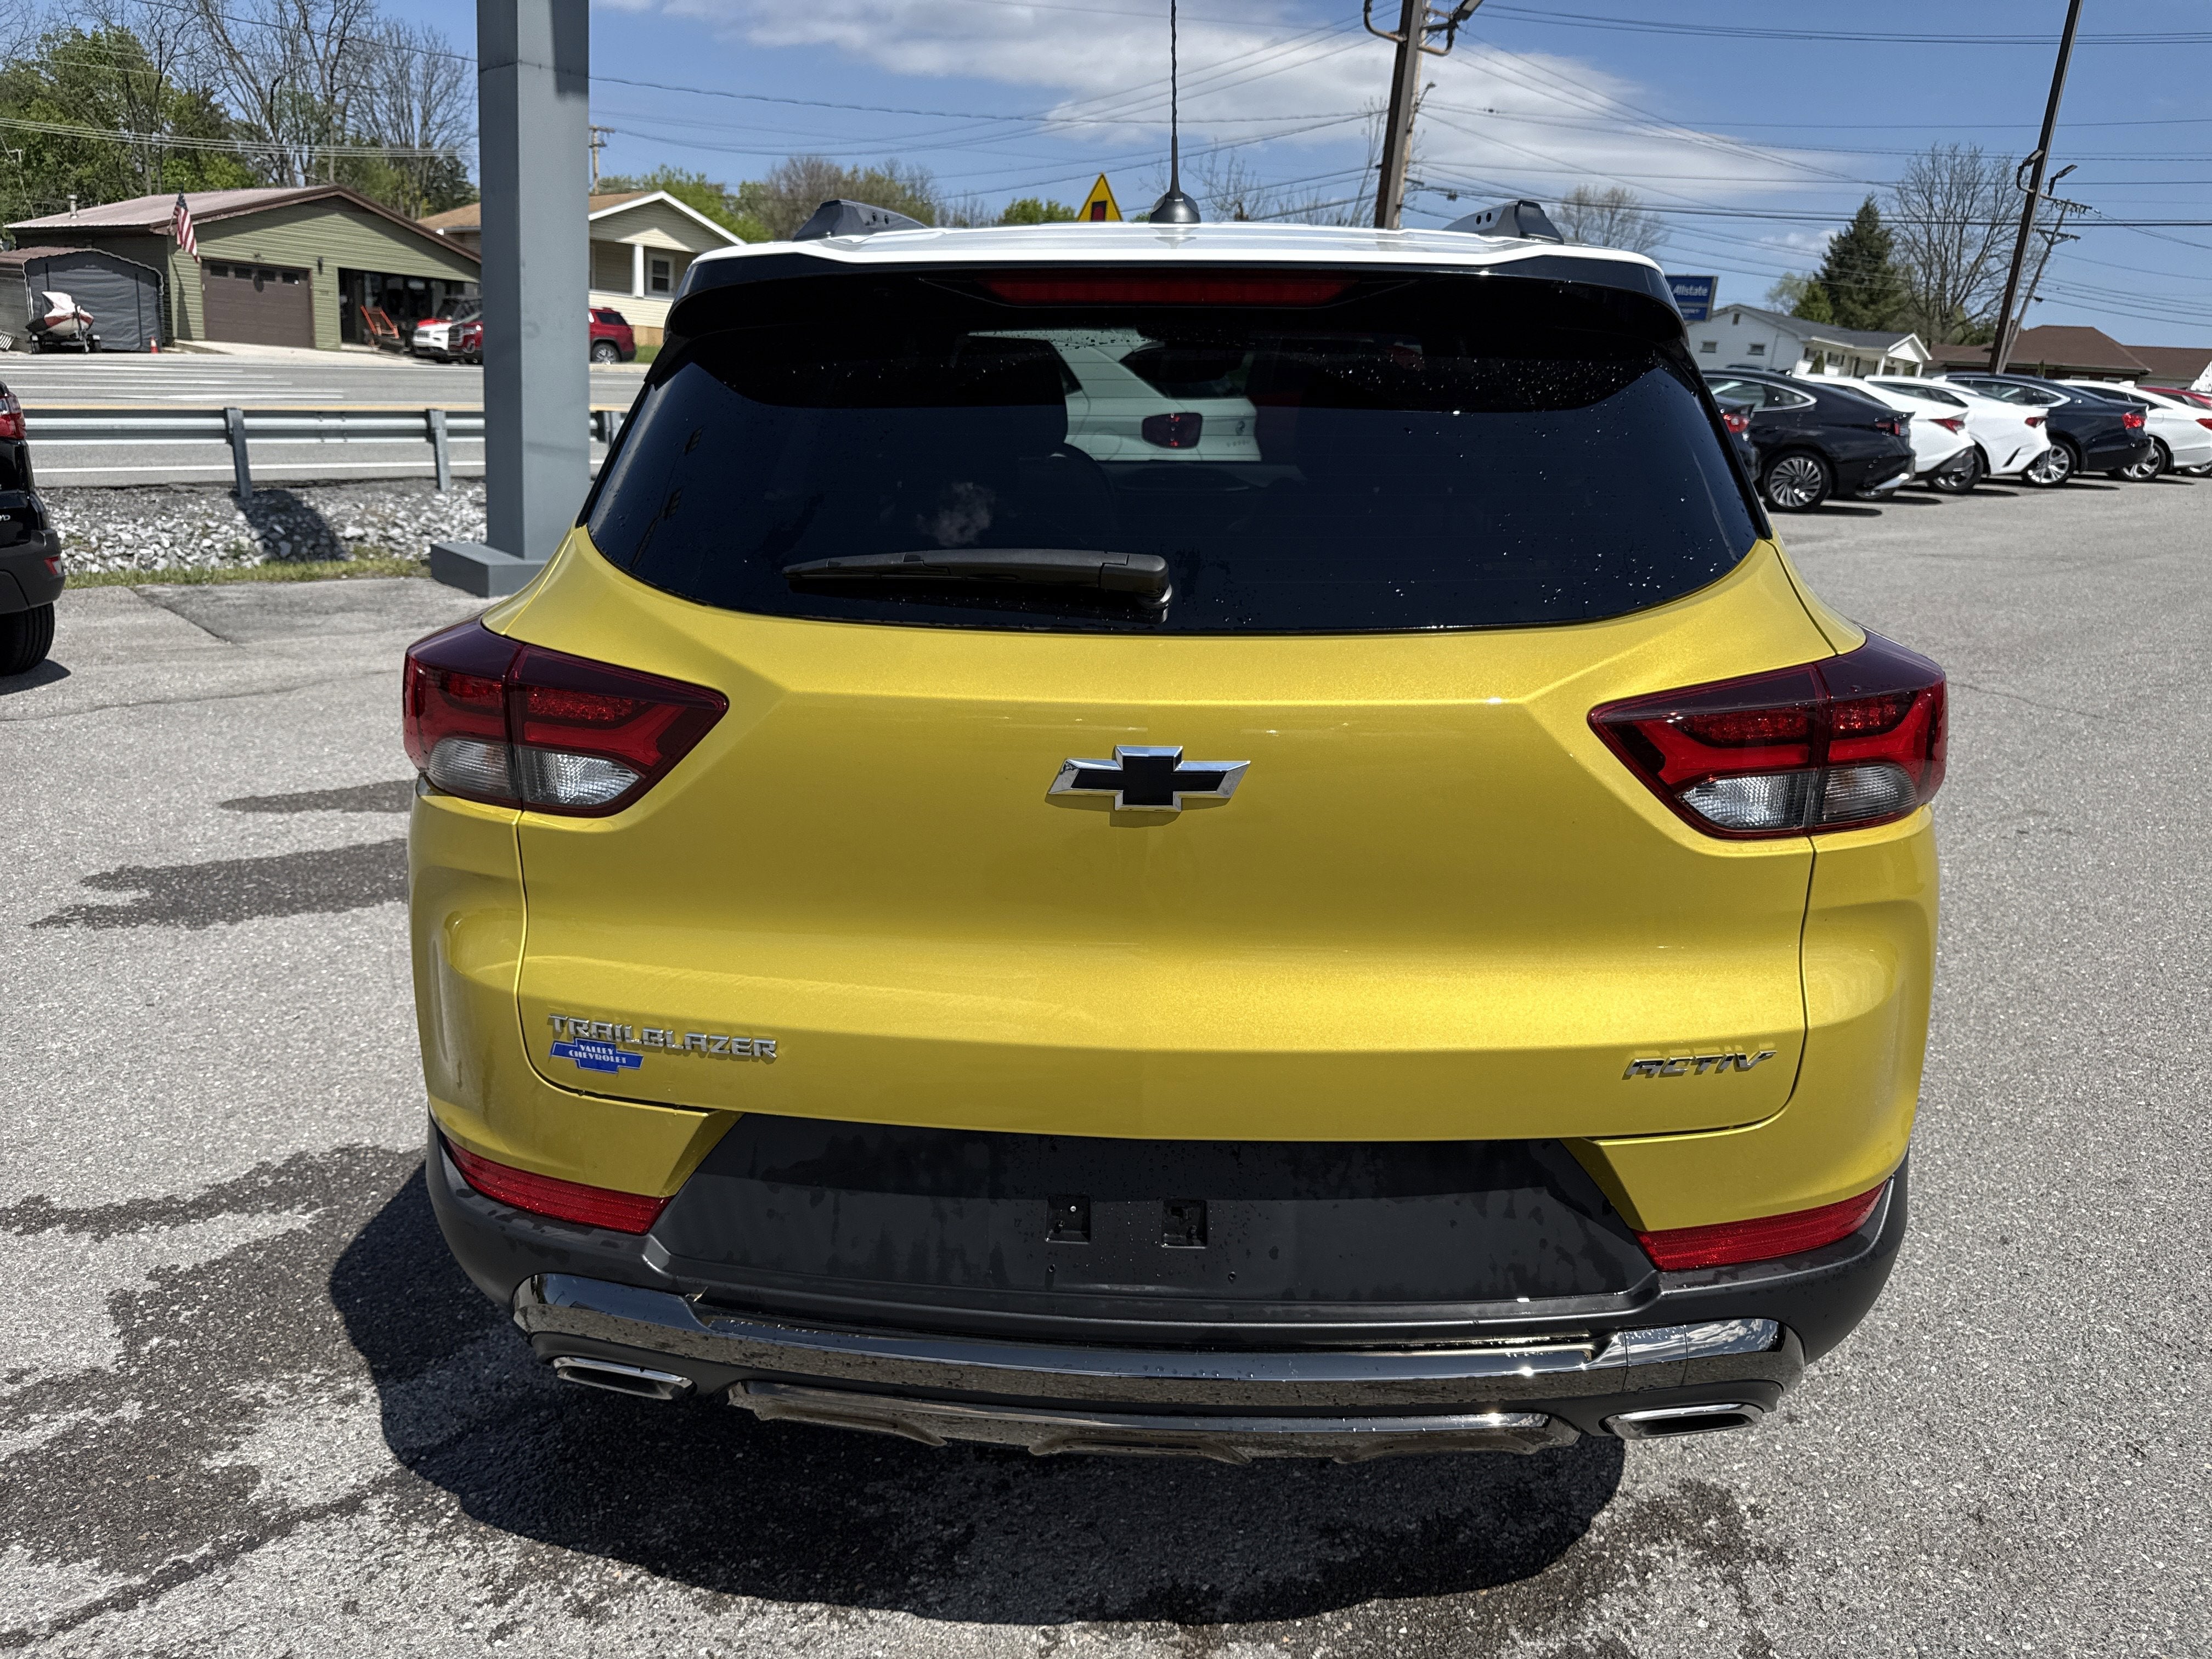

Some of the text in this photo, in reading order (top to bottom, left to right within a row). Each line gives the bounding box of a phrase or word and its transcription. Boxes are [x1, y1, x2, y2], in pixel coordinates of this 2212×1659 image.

[1673, 284, 1708, 296] Allstate
[548, 1013, 778, 1058] TRAILBLAZER
[568, 1049, 625, 1064] CHEVROLET
[579, 1044, 614, 1055] VALLEY
[1624, 1049, 1778, 1076] ACTIV
